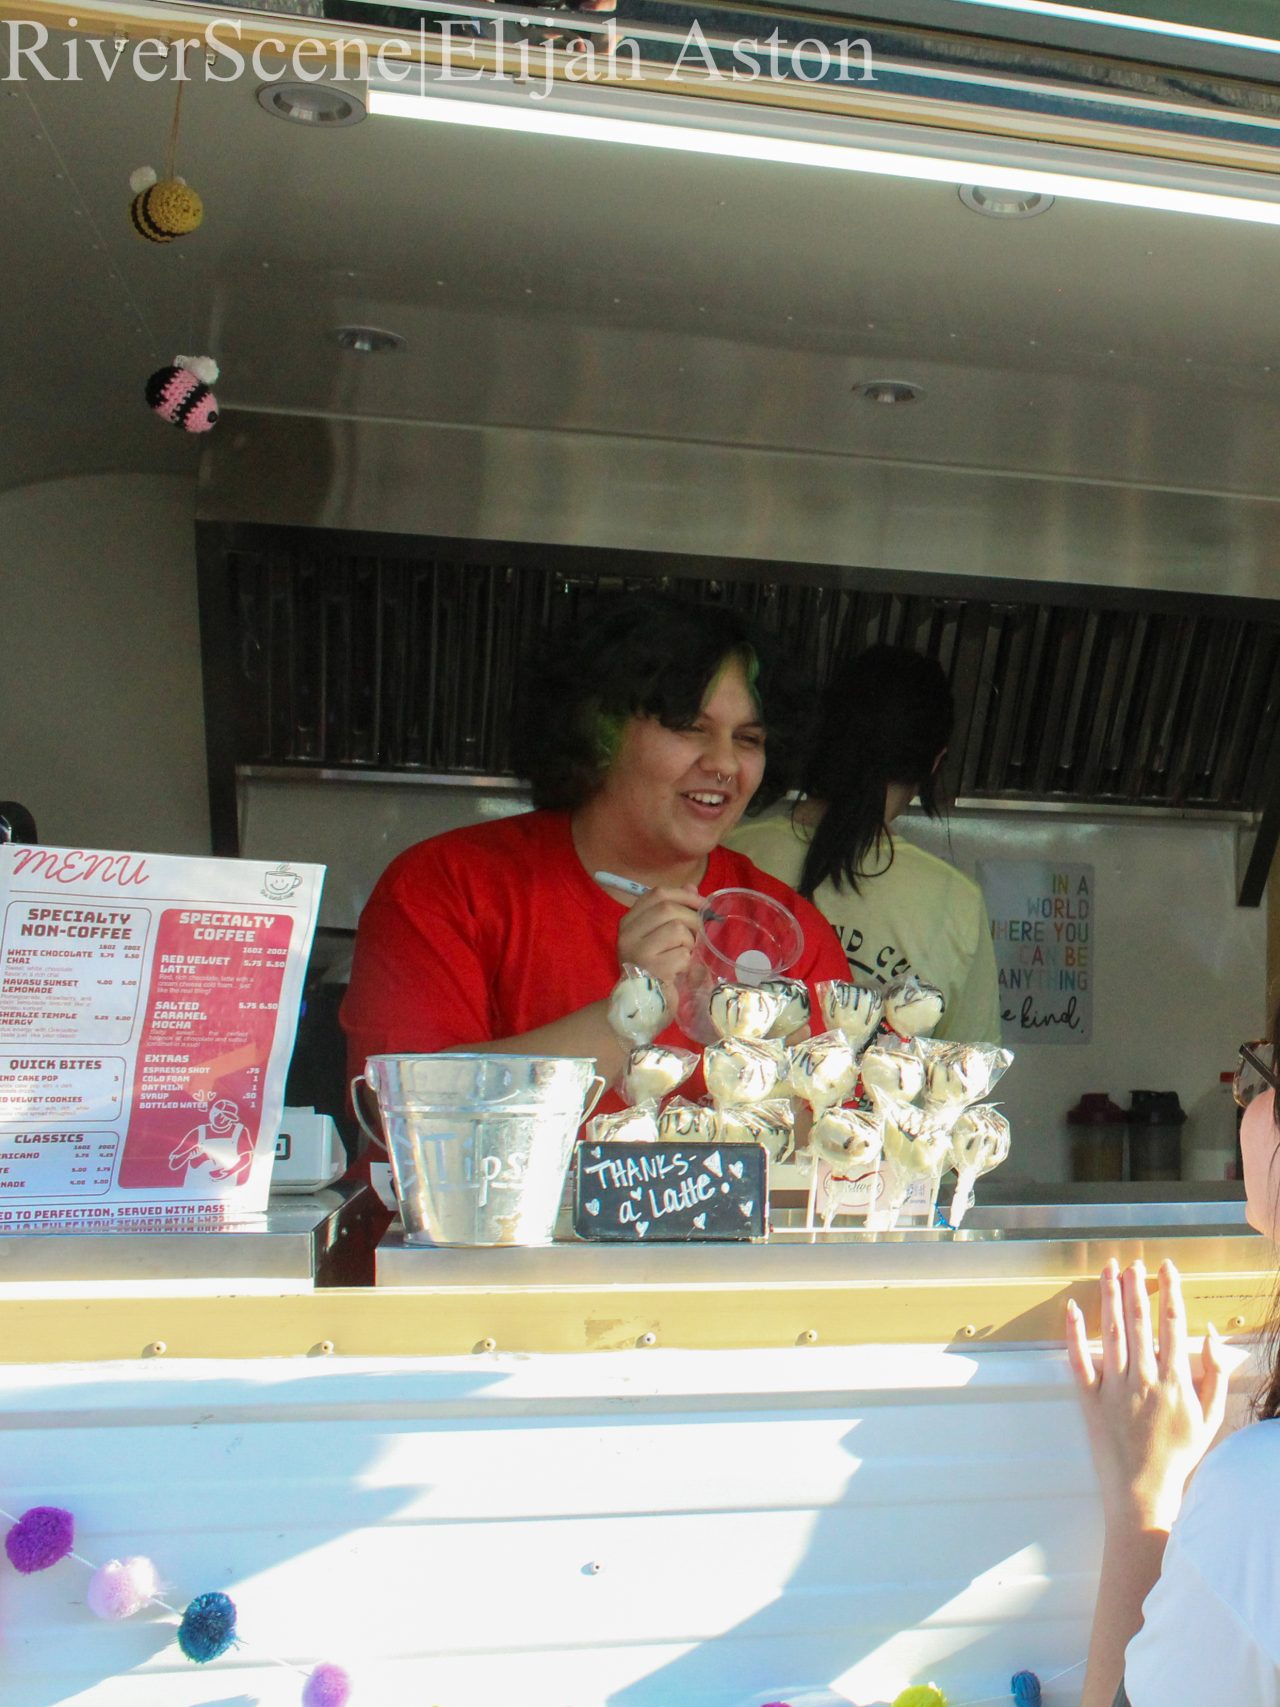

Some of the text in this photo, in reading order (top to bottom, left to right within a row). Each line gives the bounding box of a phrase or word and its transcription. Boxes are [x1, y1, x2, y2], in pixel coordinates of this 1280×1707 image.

[13, 848, 150, 886] MENU
[1052, 874, 1089, 895] IN A
[1028, 898, 1090, 920] WORLD
[28, 908, 132, 925] SPECIALTY
[179, 912, 275, 929] SPECIALTY
[21, 923, 133, 940] NON-COFFEE
[193, 928, 256, 943] COFFEE
[1054, 922, 1089, 943] YOU
[7, 949, 40, 957] WHITE
[40, 950, 93, 958] CHOCOLATE
[1065, 946, 1089, 968] BE
[6, 957, 31, 965] CHAI
[161, 954, 285, 968] RED VELVET 5.75 6.50
[160, 964, 196, 974] LATTE
[3, 978, 41, 986] HAVASU
[43, 979, 79, 987] SUNSET
[2, 986, 53, 994] LEMONADE
[155, 1000, 199, 1010] SALTED
[259, 1002, 279, 1010] 6.50
[42, 1012, 78, 1020] TEMPLE
[153, 1010, 207, 1020] CARAMEL
[1021, 995, 1085, 1034] kind.
[0, 1018, 33, 1026] NERGY
[152, 1020, 192, 1029] MOCHA
[145, 1054, 190, 1063] EXTRAS
[10, 1059, 102, 1070] QUICK BITES
[143, 1066, 187, 1074] ESPRESSO
[166, 1075, 190, 1083] FOAM
[14, 1133, 84, 1144] CLASSICS
[16, 1210, 31, 1220] TO
[34, 1207, 115, 1219] PERFECTION,
[117, 1206, 162, 1216] SERVED
[165, 1205, 195, 1215] WITH
[619, 1200, 642, 1224] a
